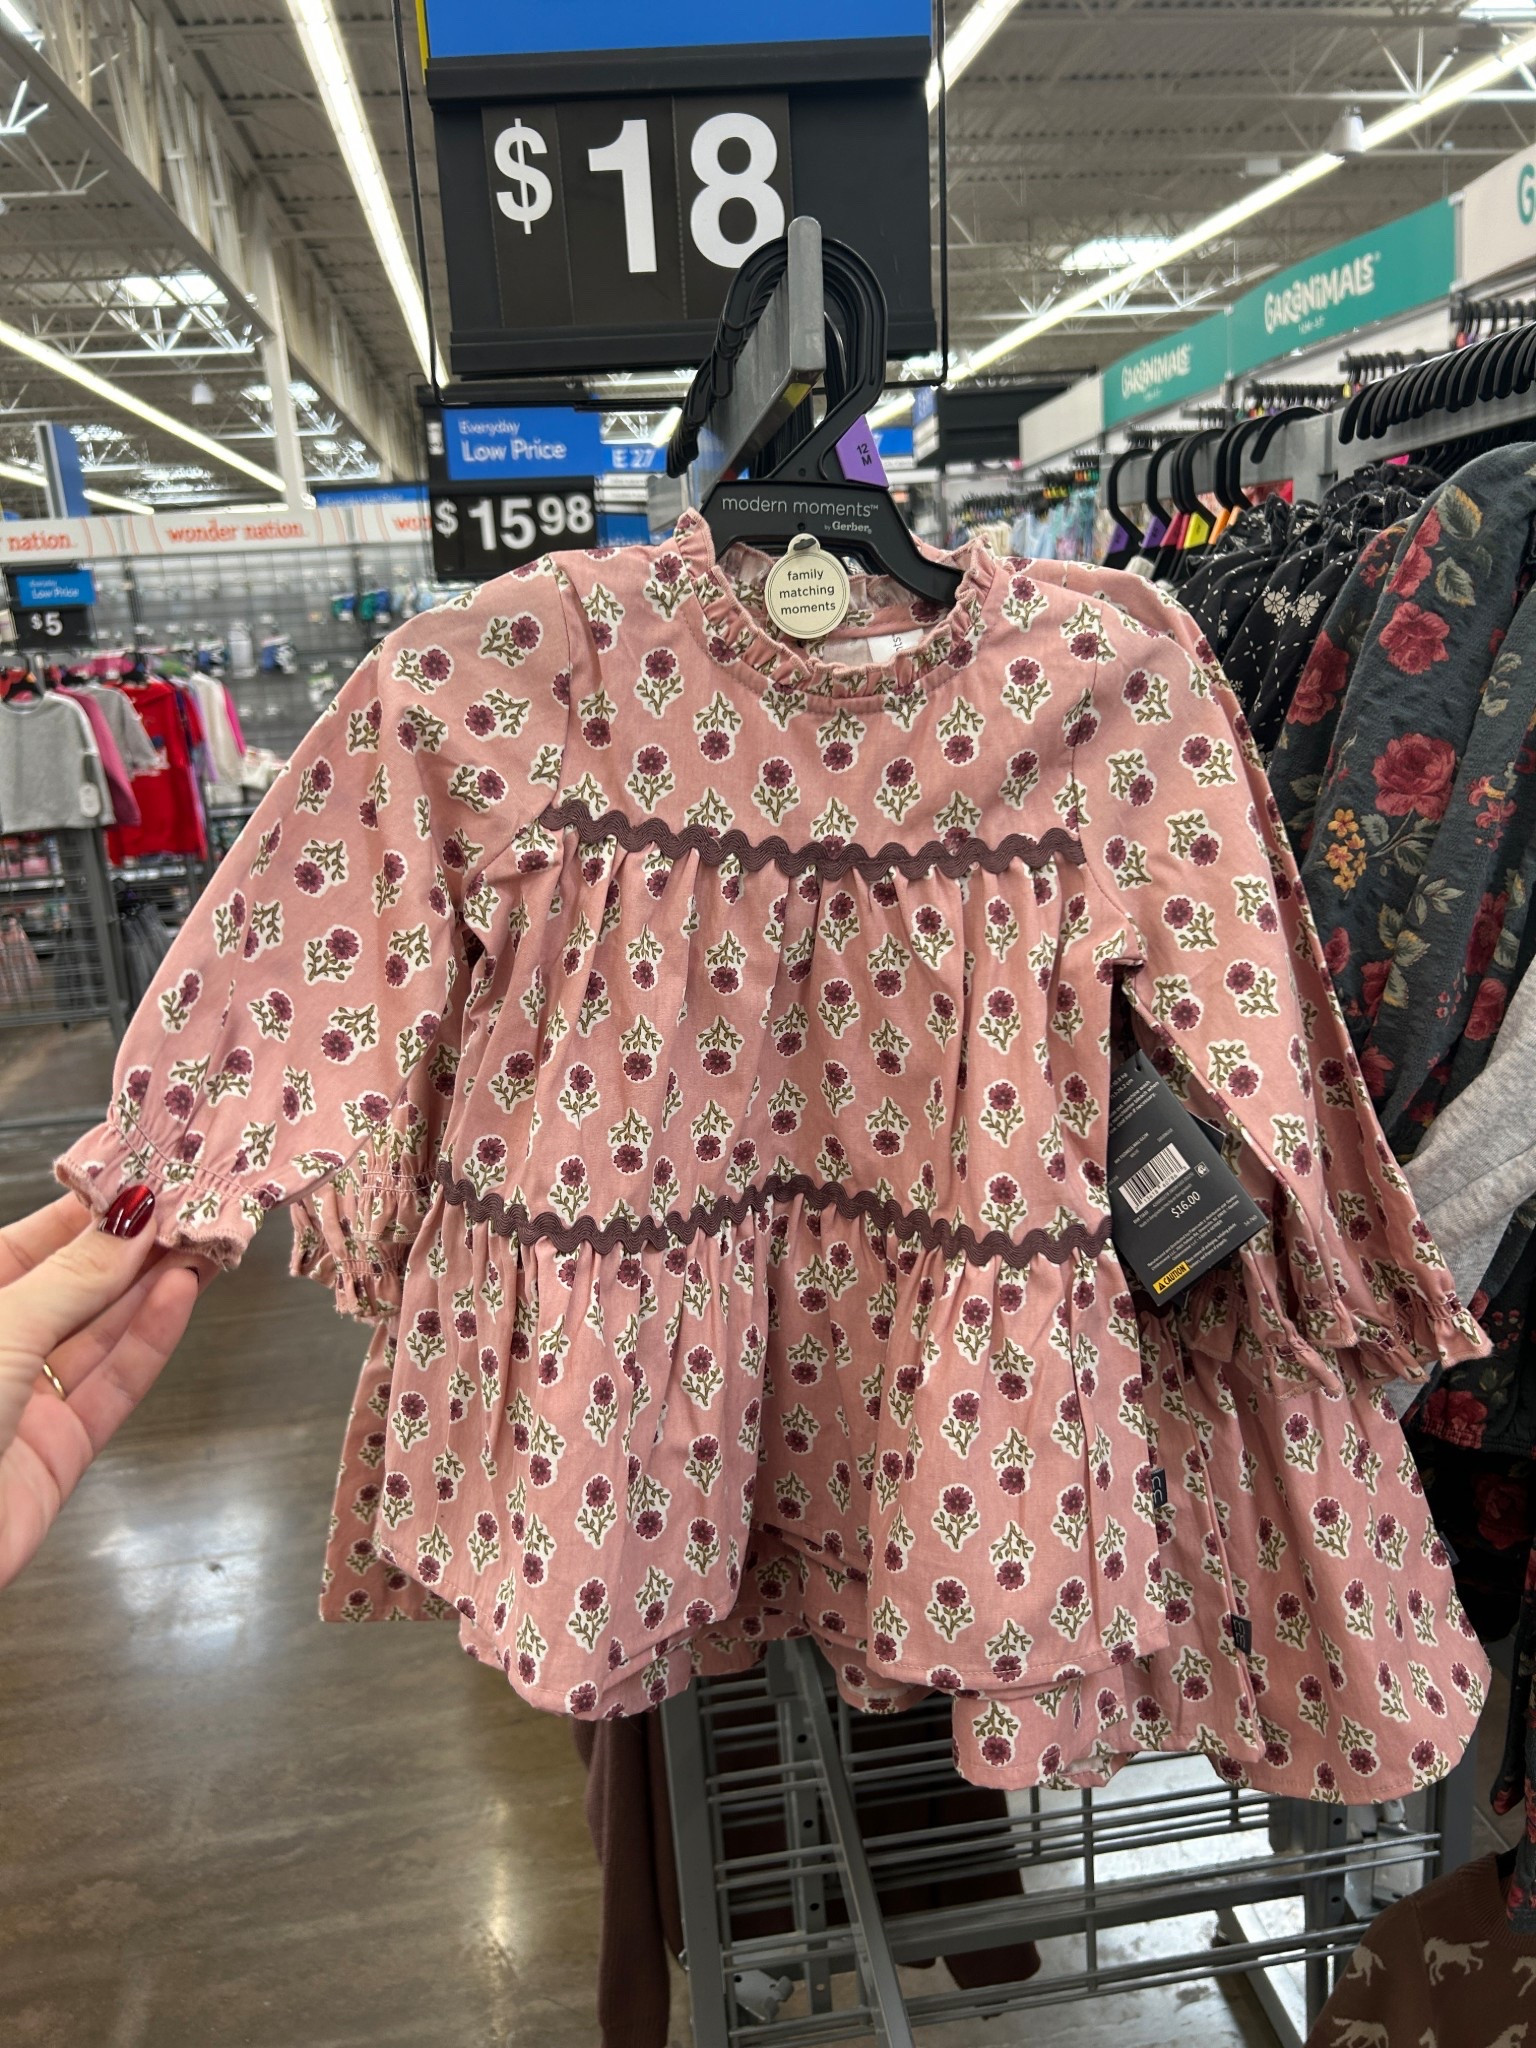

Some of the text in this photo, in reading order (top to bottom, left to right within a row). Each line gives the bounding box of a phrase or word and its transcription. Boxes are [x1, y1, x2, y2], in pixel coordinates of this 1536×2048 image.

[458, 419, 520, 438] Everyday
[461, 438, 507, 462] Low
[510, 437, 568, 461] Price
[856, 443, 869, 455] 12
[862, 456, 872, 467] M
[722, 495, 787, 513] modern
[166, 517, 306, 543] wonder nation
[7, 532, 72, 553] nation
[787, 568, 824, 582] family
[779, 585, 835, 599] matching
[780, 601, 836, 616] moments
[1169, 1189, 1201, 1218] $16.00
[1161, 1264, 1186, 1285] CAUTION
